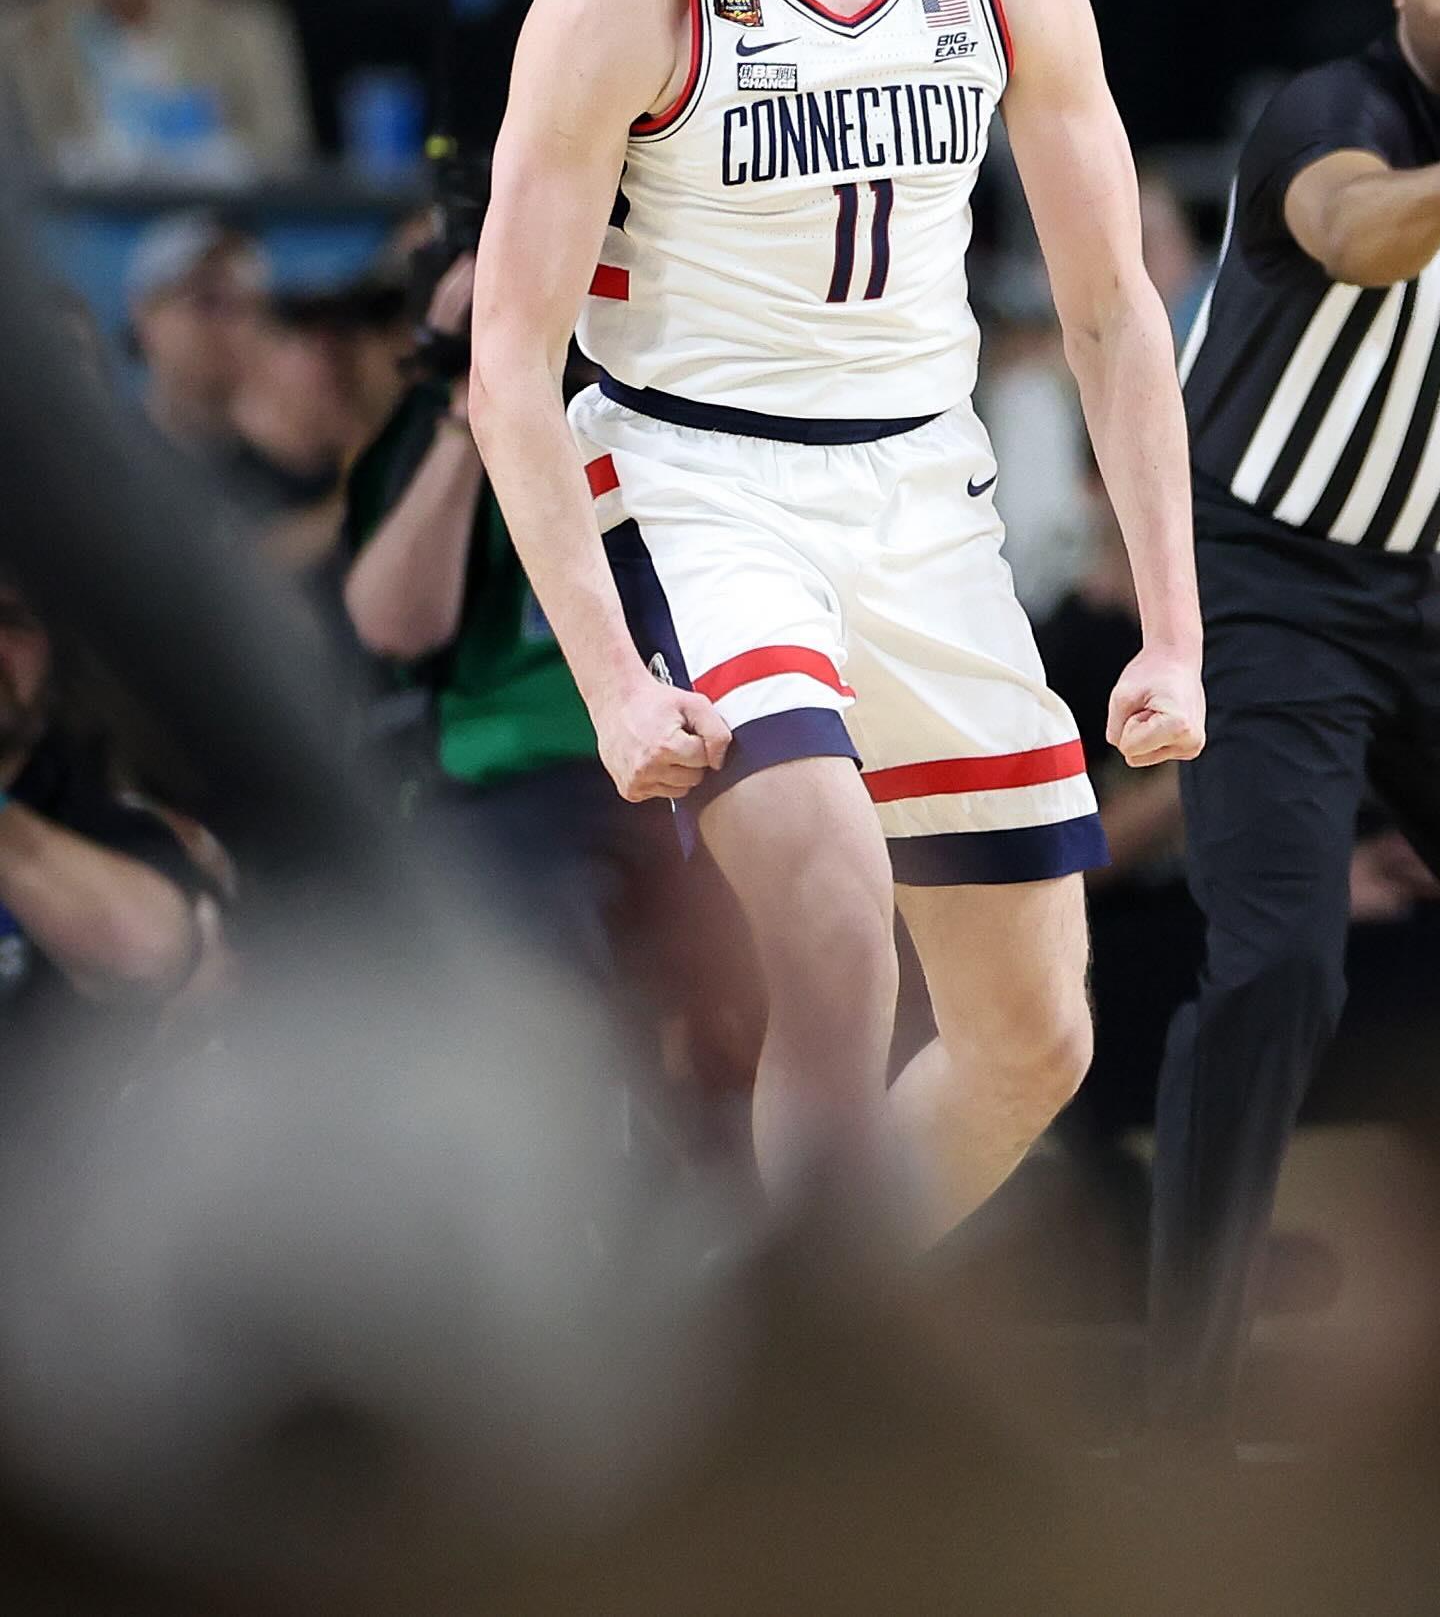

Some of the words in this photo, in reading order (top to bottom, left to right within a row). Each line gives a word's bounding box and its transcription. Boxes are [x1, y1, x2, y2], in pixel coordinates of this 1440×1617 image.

[937, 32, 967, 47] BIG
[935, 41, 979, 57] EAST
[739, 77, 796, 89] CHANGE
[722, 85, 983, 186] CONNECTICUT
[825, 178, 893, 303] 11
